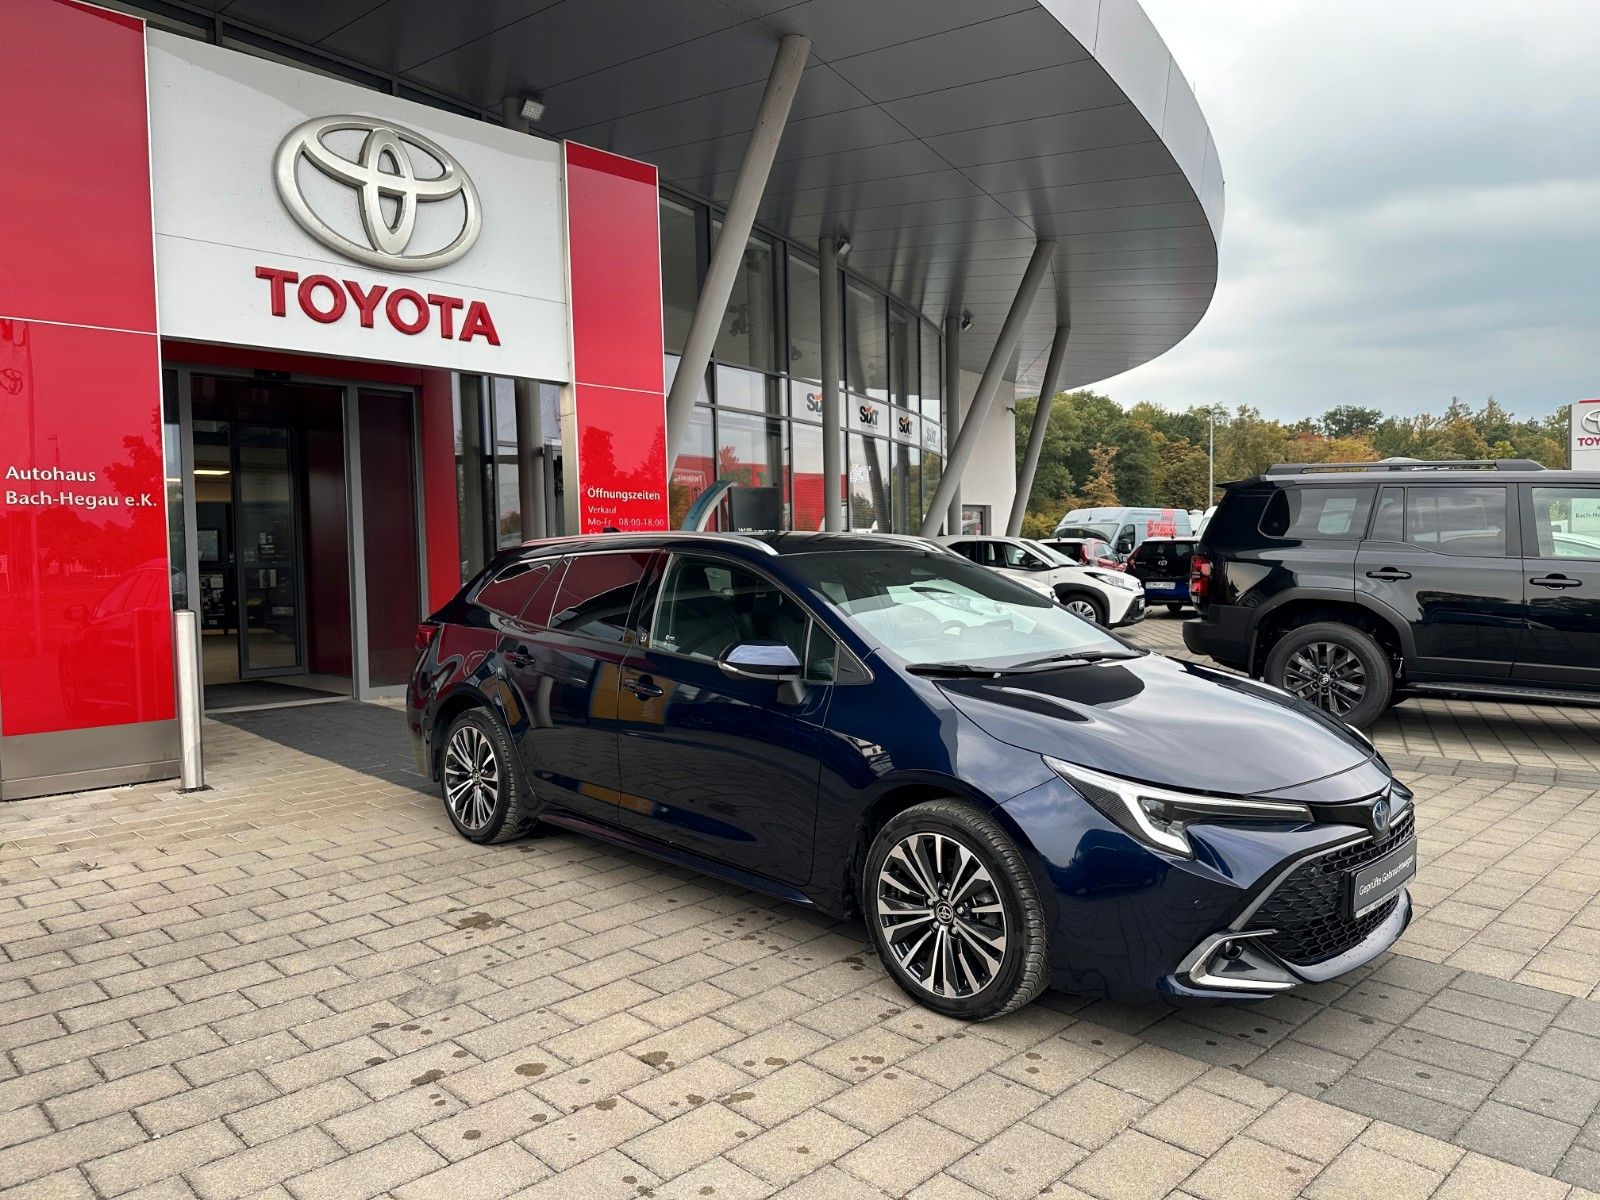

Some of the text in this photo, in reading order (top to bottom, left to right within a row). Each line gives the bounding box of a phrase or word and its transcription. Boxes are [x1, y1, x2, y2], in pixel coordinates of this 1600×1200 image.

[255, 266, 501, 346] TOYOTA
[5, 466, 96, 482] Autohaus
[5, 491, 158, 509] Bach-Hegau e.K.
[587, 486, 661, 502] Öffnungszeiten
[588, 505, 617, 514] Verkauf
[618, 518, 665, 527] 08:00-18:00
